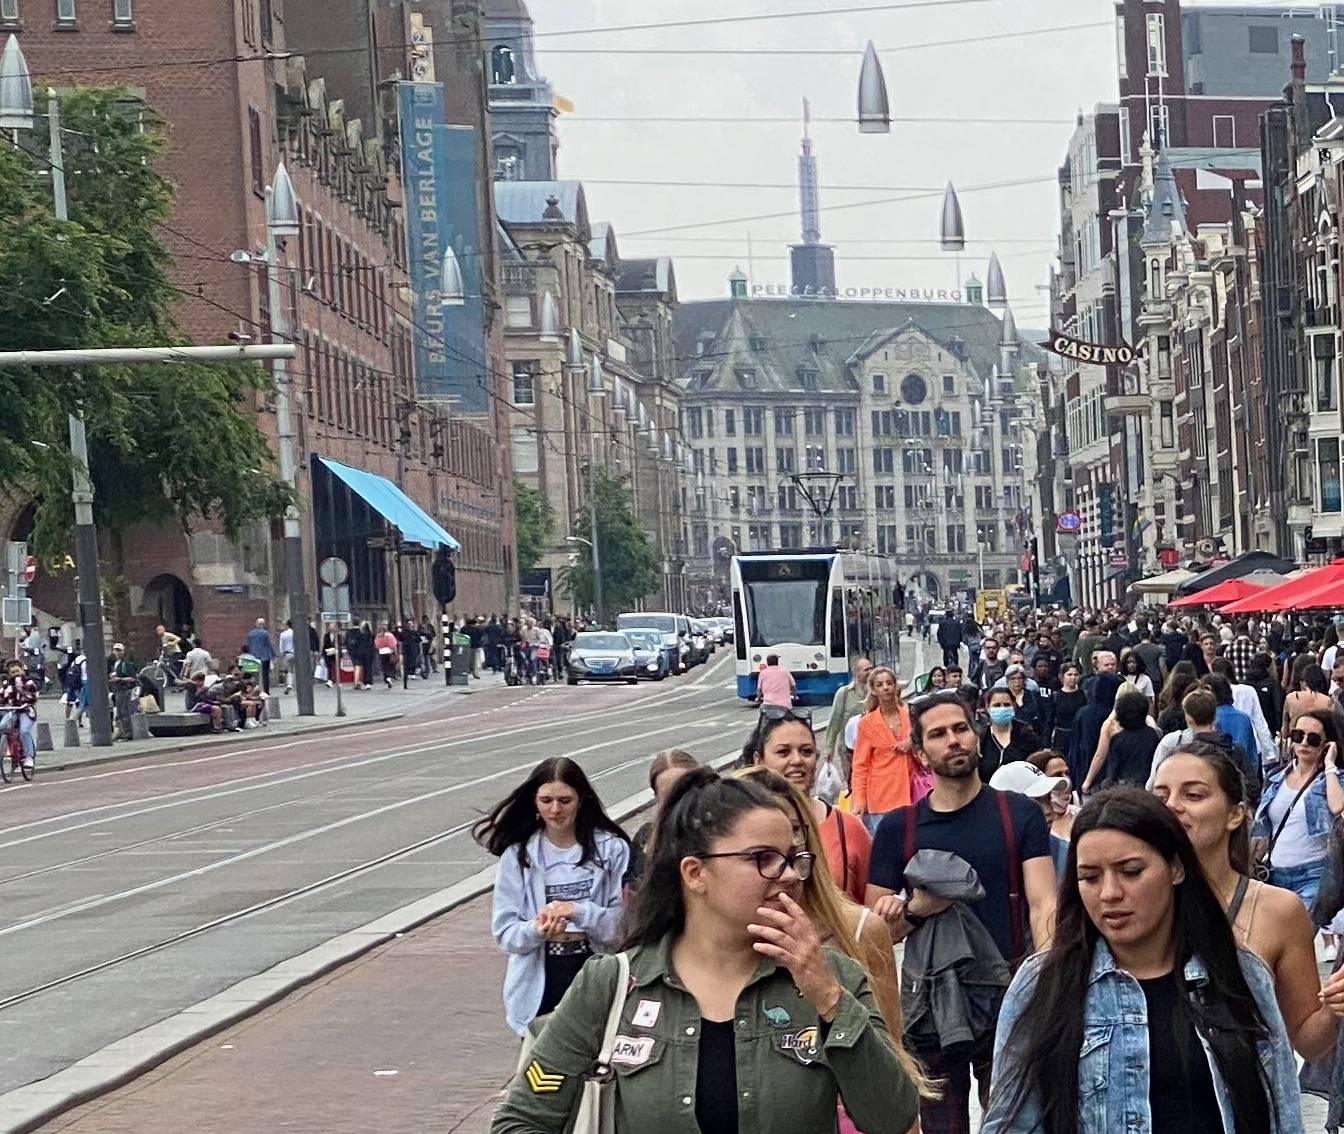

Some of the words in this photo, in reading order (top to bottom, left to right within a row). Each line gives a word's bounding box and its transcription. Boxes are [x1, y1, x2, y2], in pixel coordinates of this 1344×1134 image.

[415, 117, 436, 224] BERLAGE
[422, 231, 442, 281] VAN
[1054, 337, 1132, 362] CASINO
[782, 1033, 812, 1050] Hard
